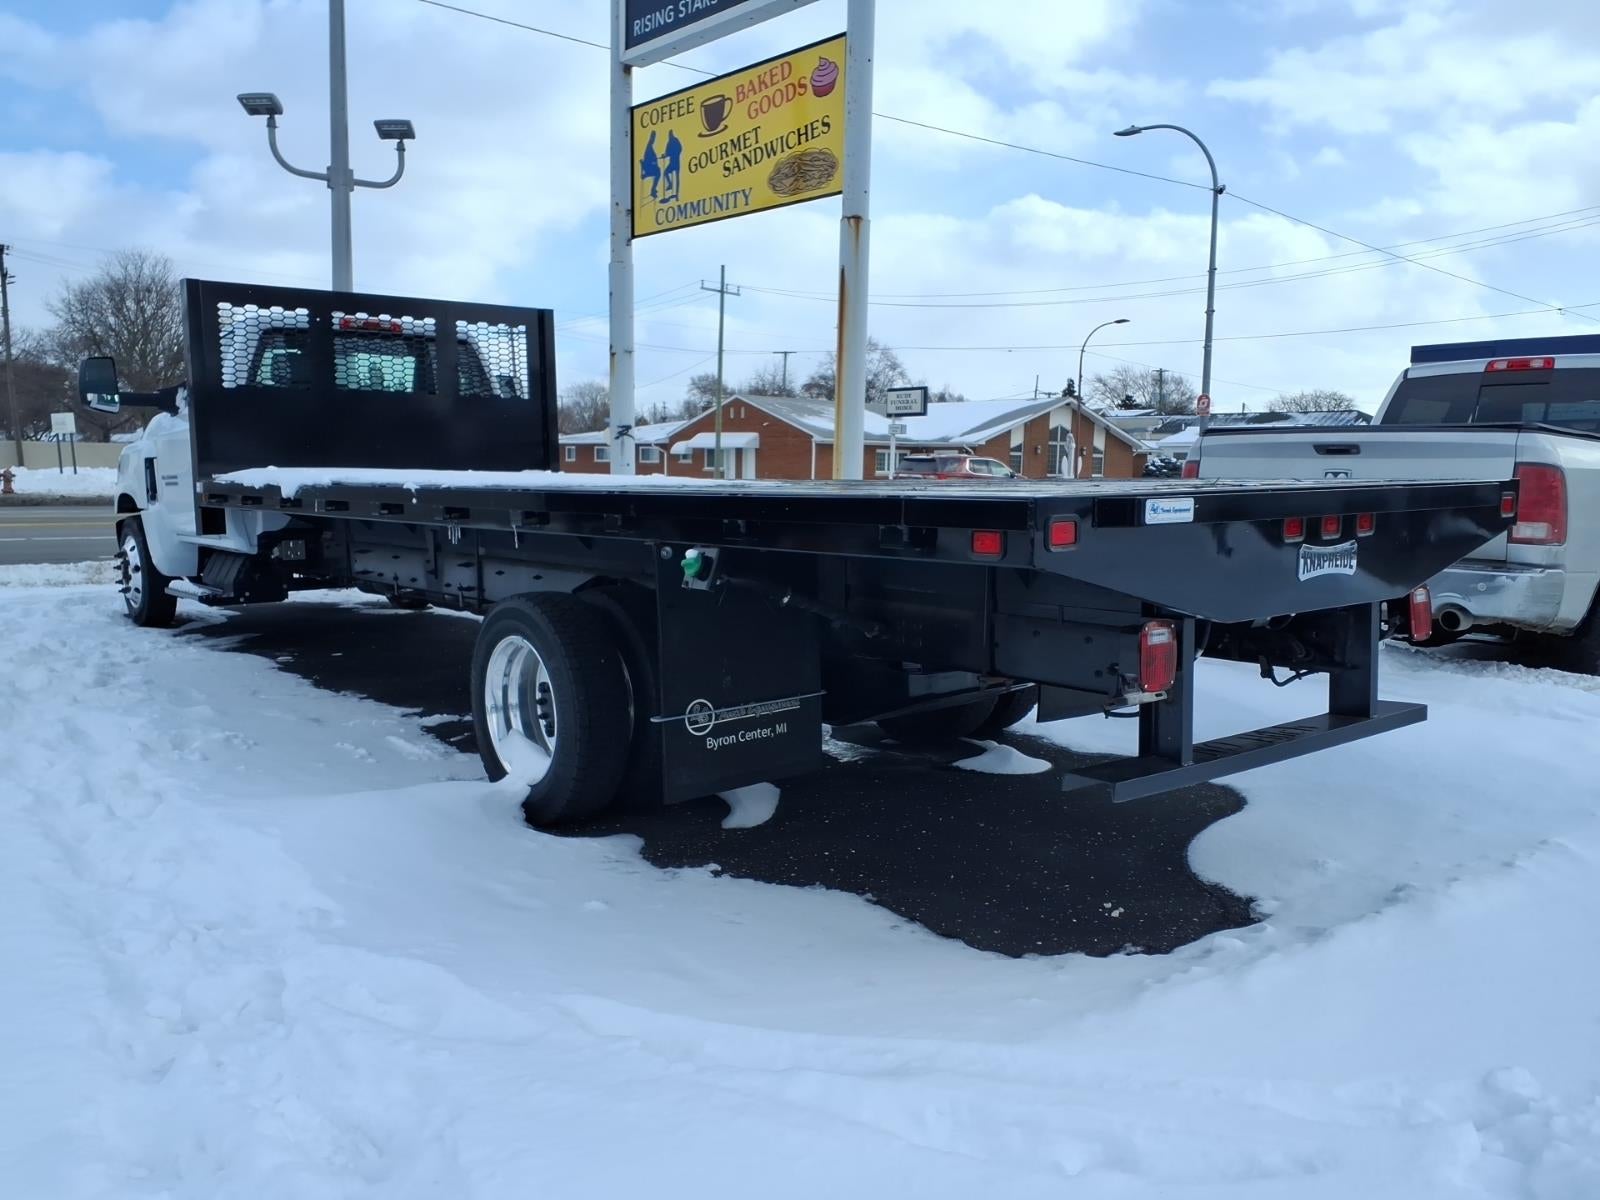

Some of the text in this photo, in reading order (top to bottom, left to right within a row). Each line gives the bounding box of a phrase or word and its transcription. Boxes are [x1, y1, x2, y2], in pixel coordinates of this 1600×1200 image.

[633, 0, 718, 37] RISING STA
[736, 60, 793, 104] BAKED
[747, 76, 808, 120] GOODS
[640, 96, 695, 129] COFFEE
[688, 126, 762, 174] GOURMET
[722, 114, 831, 178] SANDWICHES
[655, 187, 753, 226] COMMUNITY
[1301, 550, 1354, 575] KNAPHEIDE
[706, 722, 787, 751] Byron Center, MI
